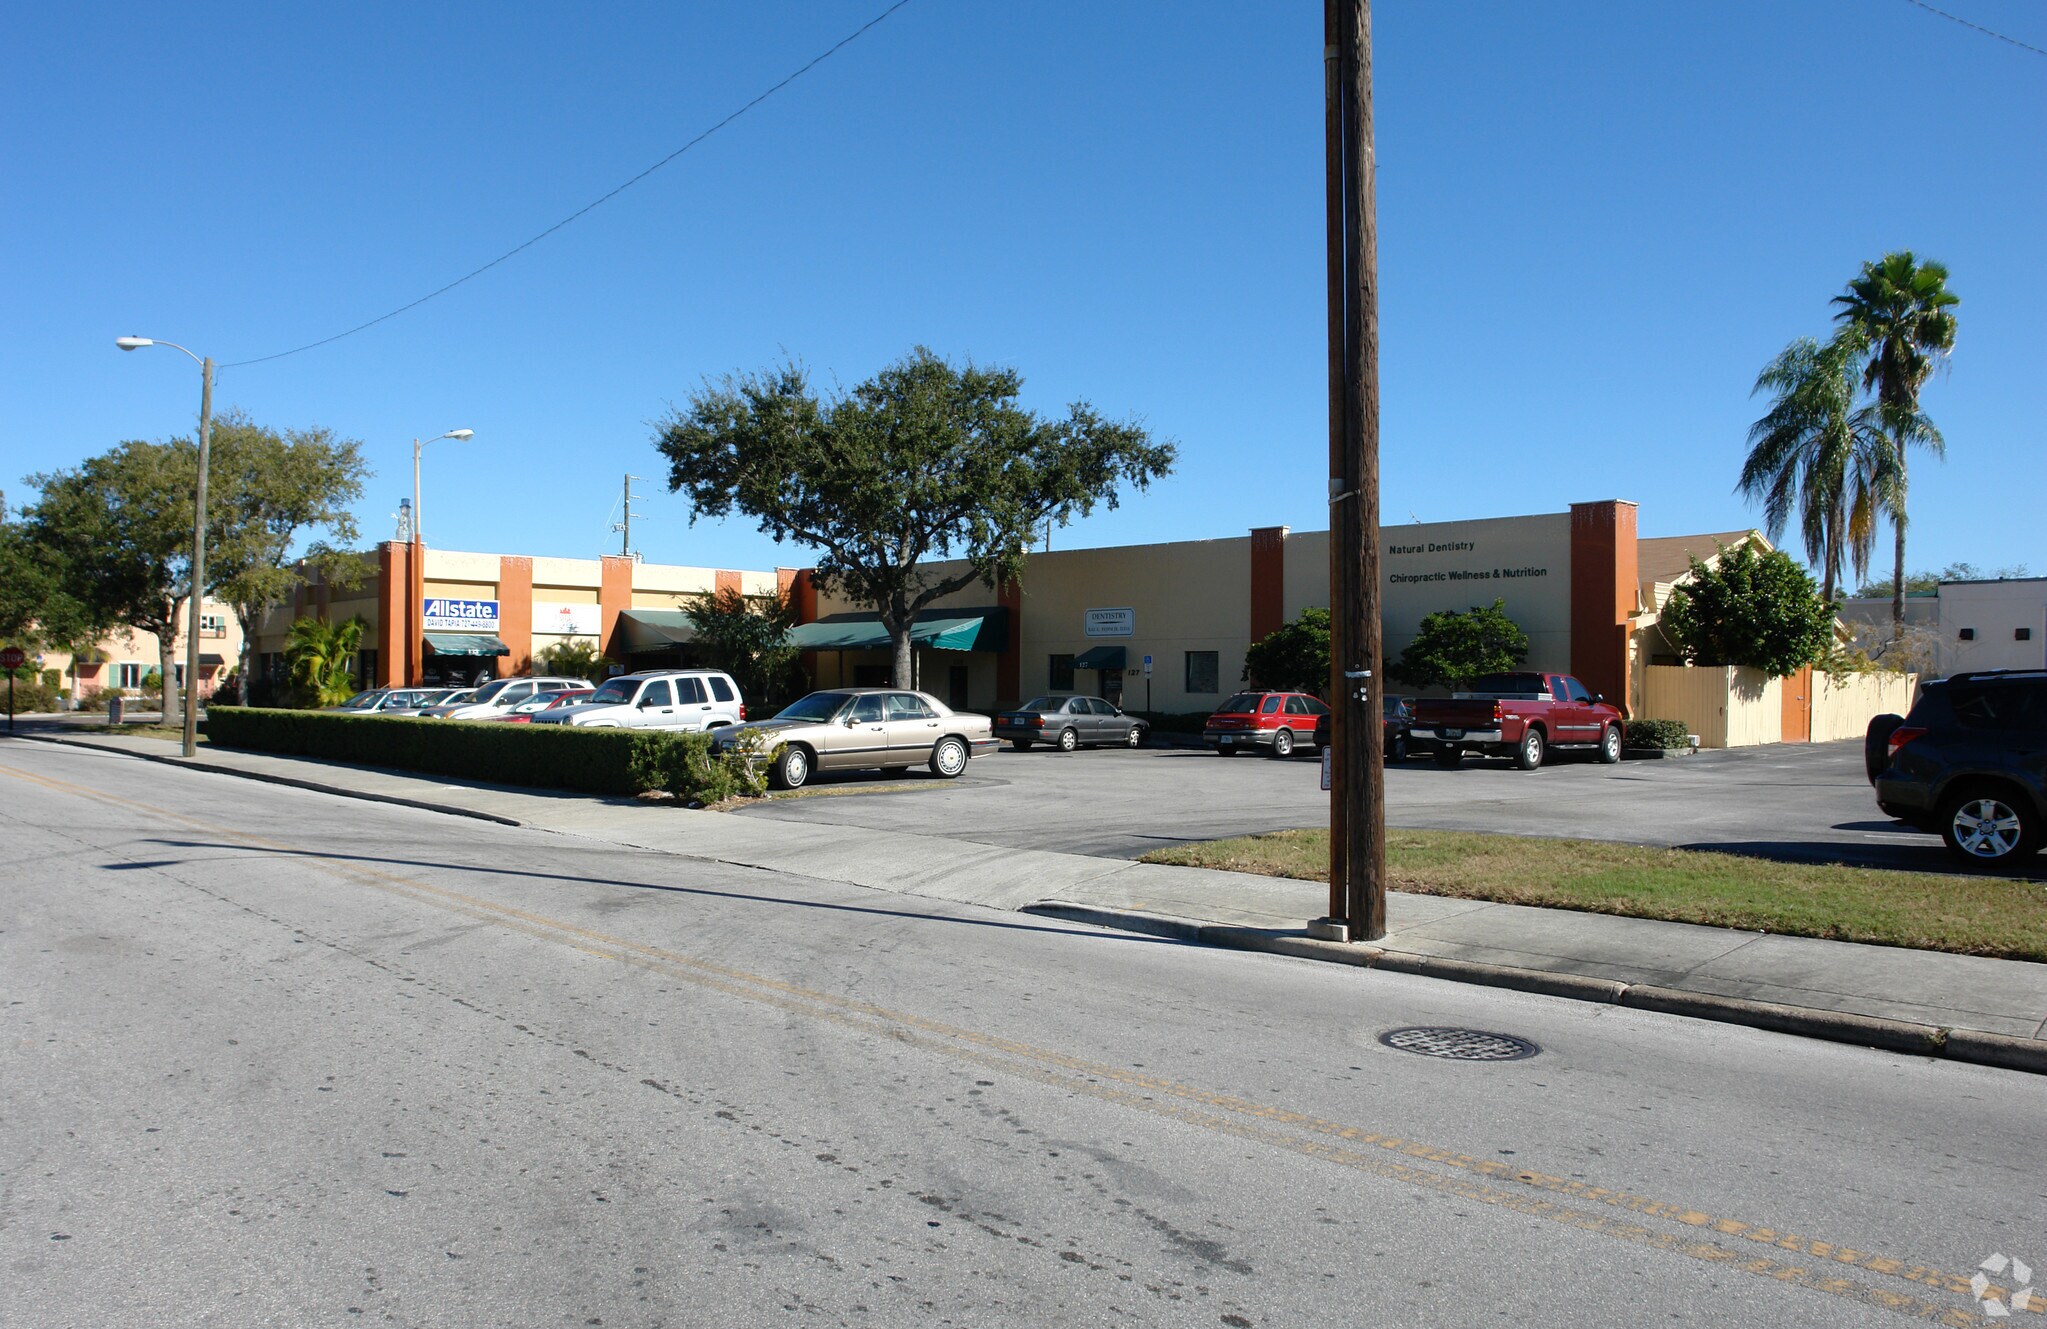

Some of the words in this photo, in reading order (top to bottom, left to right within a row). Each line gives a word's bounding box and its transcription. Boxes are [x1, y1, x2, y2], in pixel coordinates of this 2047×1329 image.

[1389, 544, 1424, 554] Natural
[1428, 541, 1475, 552] Dentistry
[1389, 572, 1446, 584] Chiropractic
[1448, 570, 1490, 581] Wellness
[1492, 568, 1500, 578] &
[1502, 566, 1547, 578] Nutrition
[427, 618, 443, 627] DAVID
[0, 653, 22, 662] STOP
